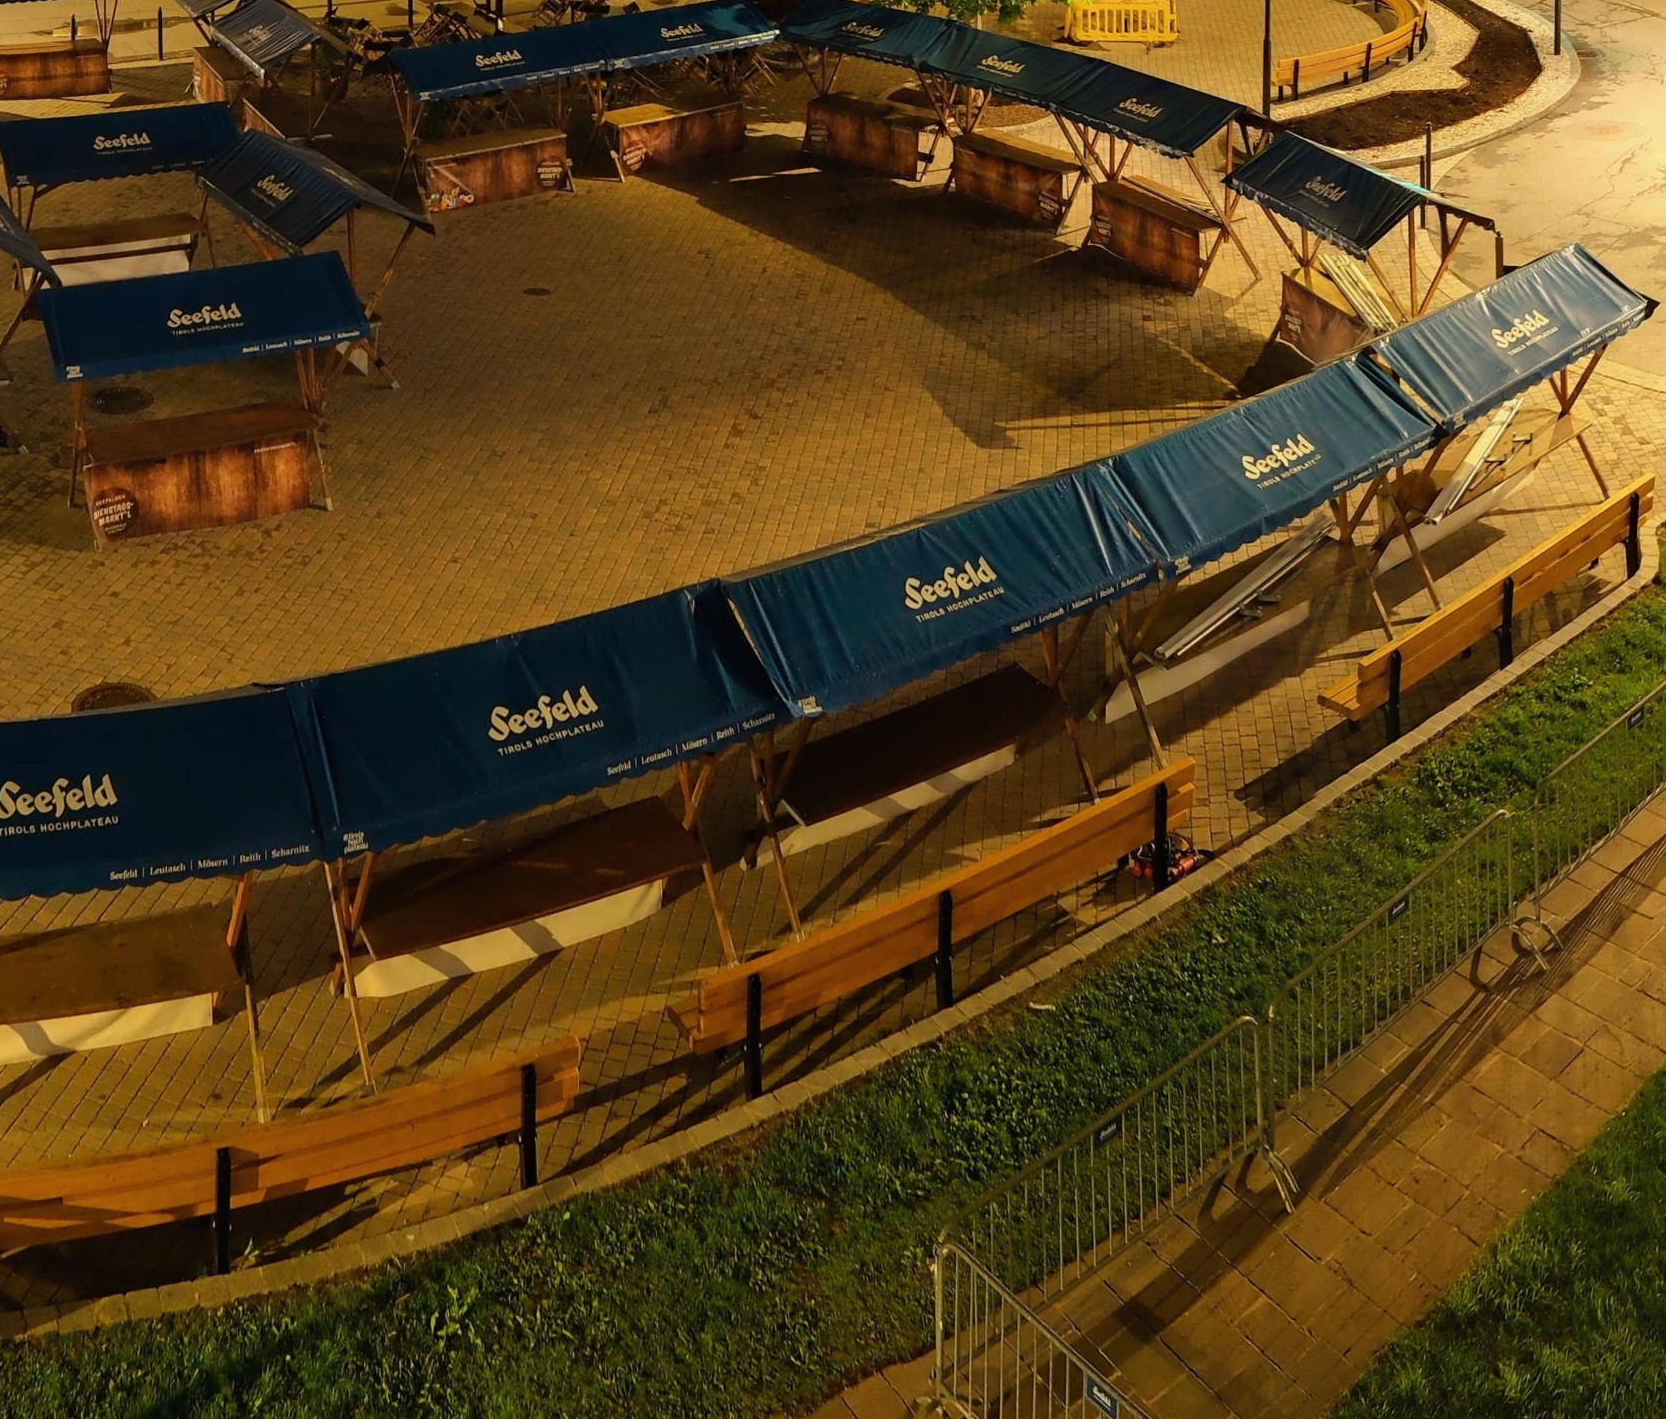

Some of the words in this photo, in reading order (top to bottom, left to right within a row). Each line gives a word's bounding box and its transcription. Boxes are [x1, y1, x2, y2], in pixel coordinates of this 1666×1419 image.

[660, 23, 703, 39] Seefeld
[475, 49, 523, 67] Seefeld
[1118, 97, 1163, 120] Seefeld
[93, 132, 151, 151] Seefeld
[167, 303, 242, 329] Seefeld
[1491, 309, 1550, 349] Seefeld
[1241, 433, 1316, 479] Seefeld
[903, 555, 998, 610] Seefeld
[915, 606, 945, 624] TIROLS
[946, 586, 1005, 613] HOCHPLATEAU
[487, 684, 599, 741] Seefeld
[498, 739, 533, 757] TIROLS
[535, 719, 605, 747] HOCHPLATEAU
[606, 759, 632, 776] Seefeld
[640, 747, 673, 766] Leutasch
[681, 735, 708, 753] Mösern
[716, 726, 735, 741] Reith
[742, 710, 776, 731] Scharnitz
[40, 815, 119, 833] HOCHPLATEAU
[110, 867, 138, 881] Seefeld
[150, 861, 186, 877] Leutasch
[198, 856, 229, 870] Mösern
[239, 850, 261, 864] Reith
[270, 842, 311, 859] Scharnitz
